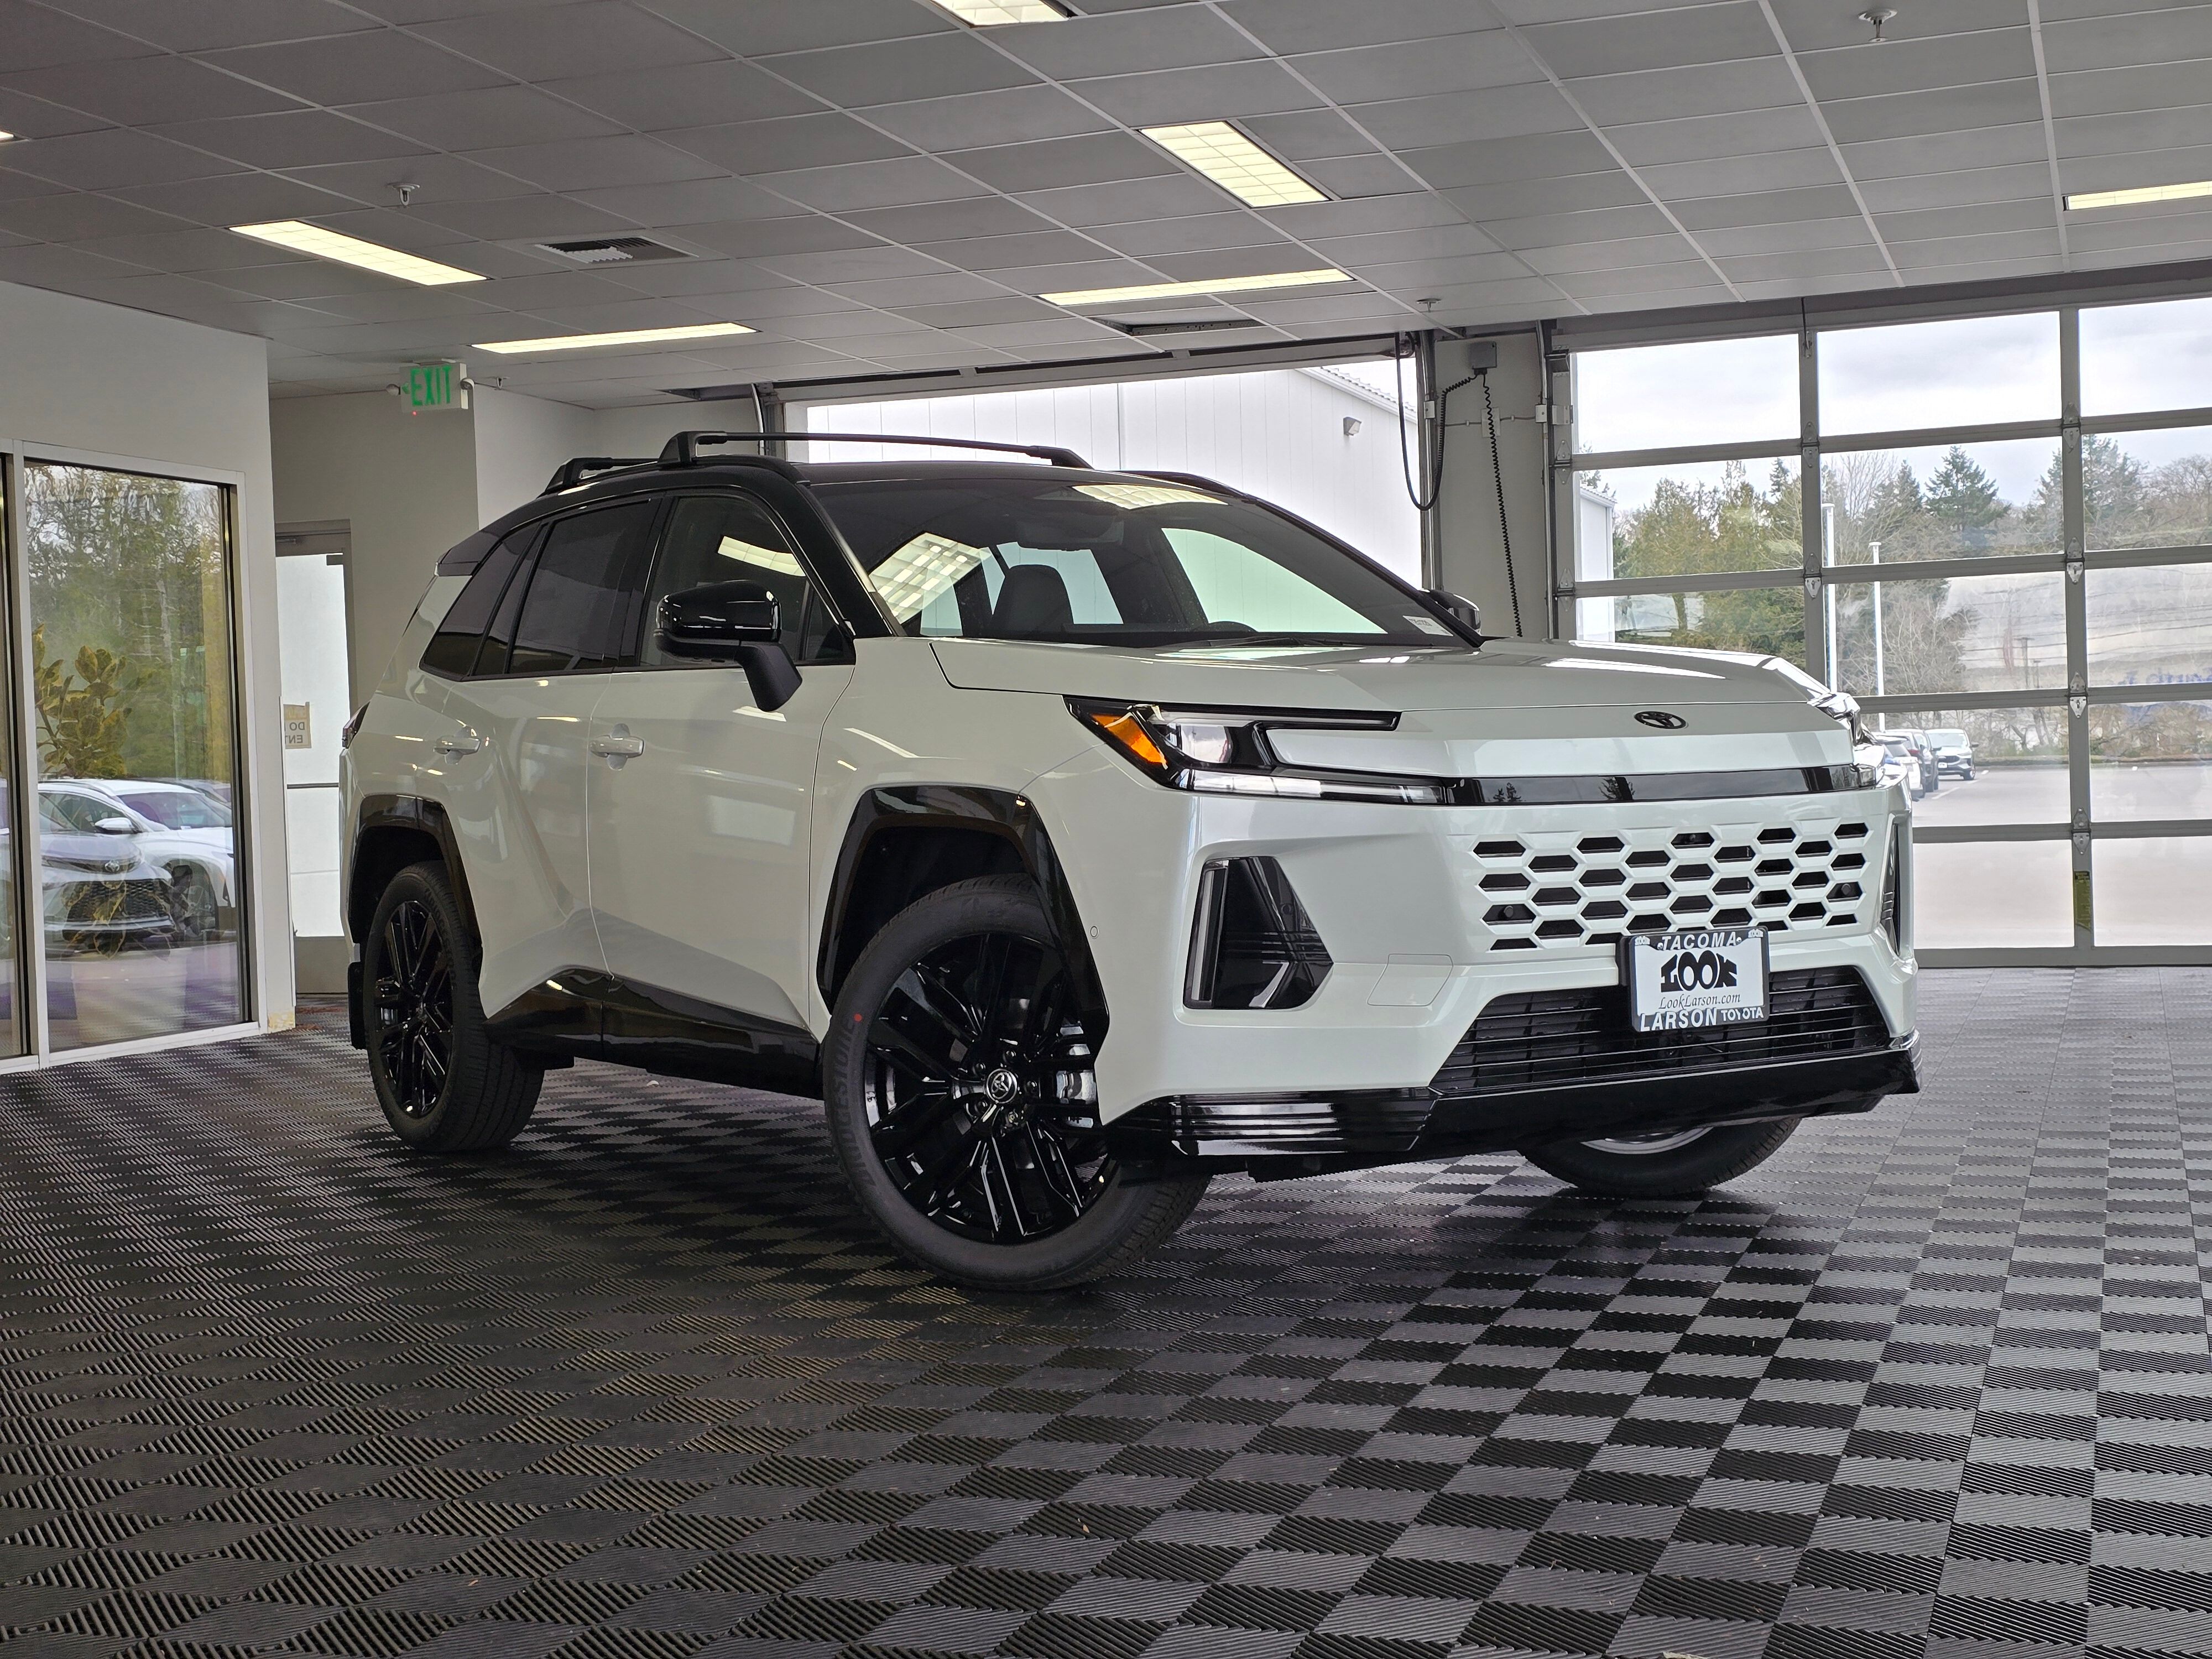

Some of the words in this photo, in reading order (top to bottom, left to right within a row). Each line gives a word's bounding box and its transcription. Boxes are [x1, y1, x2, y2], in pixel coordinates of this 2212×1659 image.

[410, 366, 452, 406] EXIT
[1661, 931, 1736, 951] TACOMA
[1661, 950, 1738, 993] LOOK
[1659, 994, 1741, 1010] LookLarson.com
[1640, 1008, 1717, 1032] LARSON
[1721, 1006, 1764, 1022] TOYOTA
